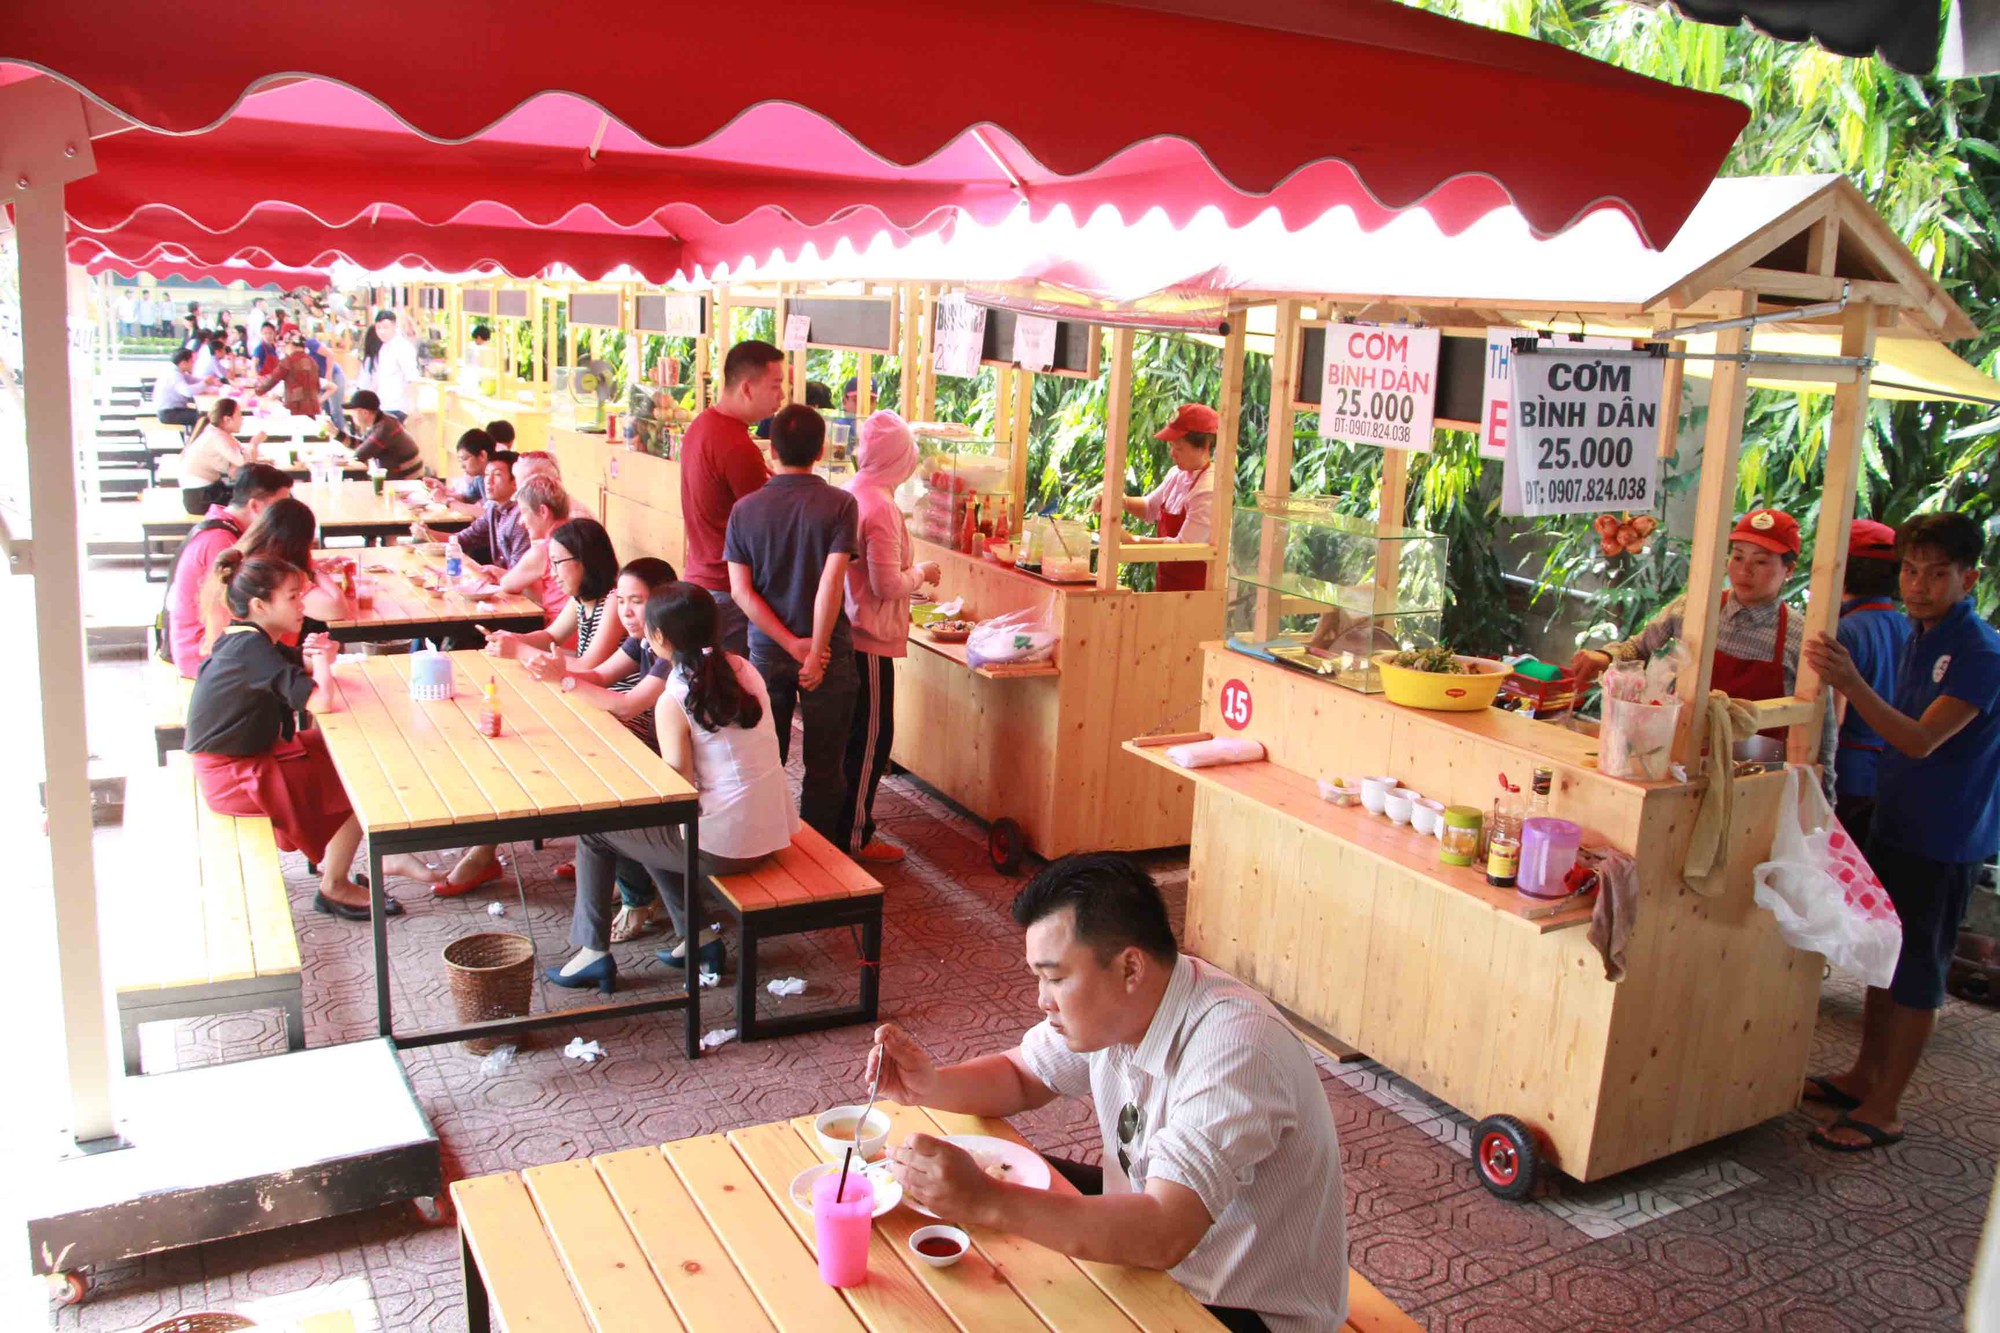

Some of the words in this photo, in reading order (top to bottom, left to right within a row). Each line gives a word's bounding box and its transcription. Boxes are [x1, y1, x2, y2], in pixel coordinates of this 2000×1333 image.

[1348, 331, 1409, 363] CƠM
[1381, 365, 1430, 395] DÂN
[1548, 360, 1632, 393] CƠM
[1336, 388, 1414, 424] 25.000
[1520, 395, 1587, 428] BÌNH
[1597, 396, 1657, 428] DÂN
[1538, 437, 1633, 470] 25.000
[1548, 477, 1647, 504] 0907.824.038
[1224, 687, 1248, 723] 15
